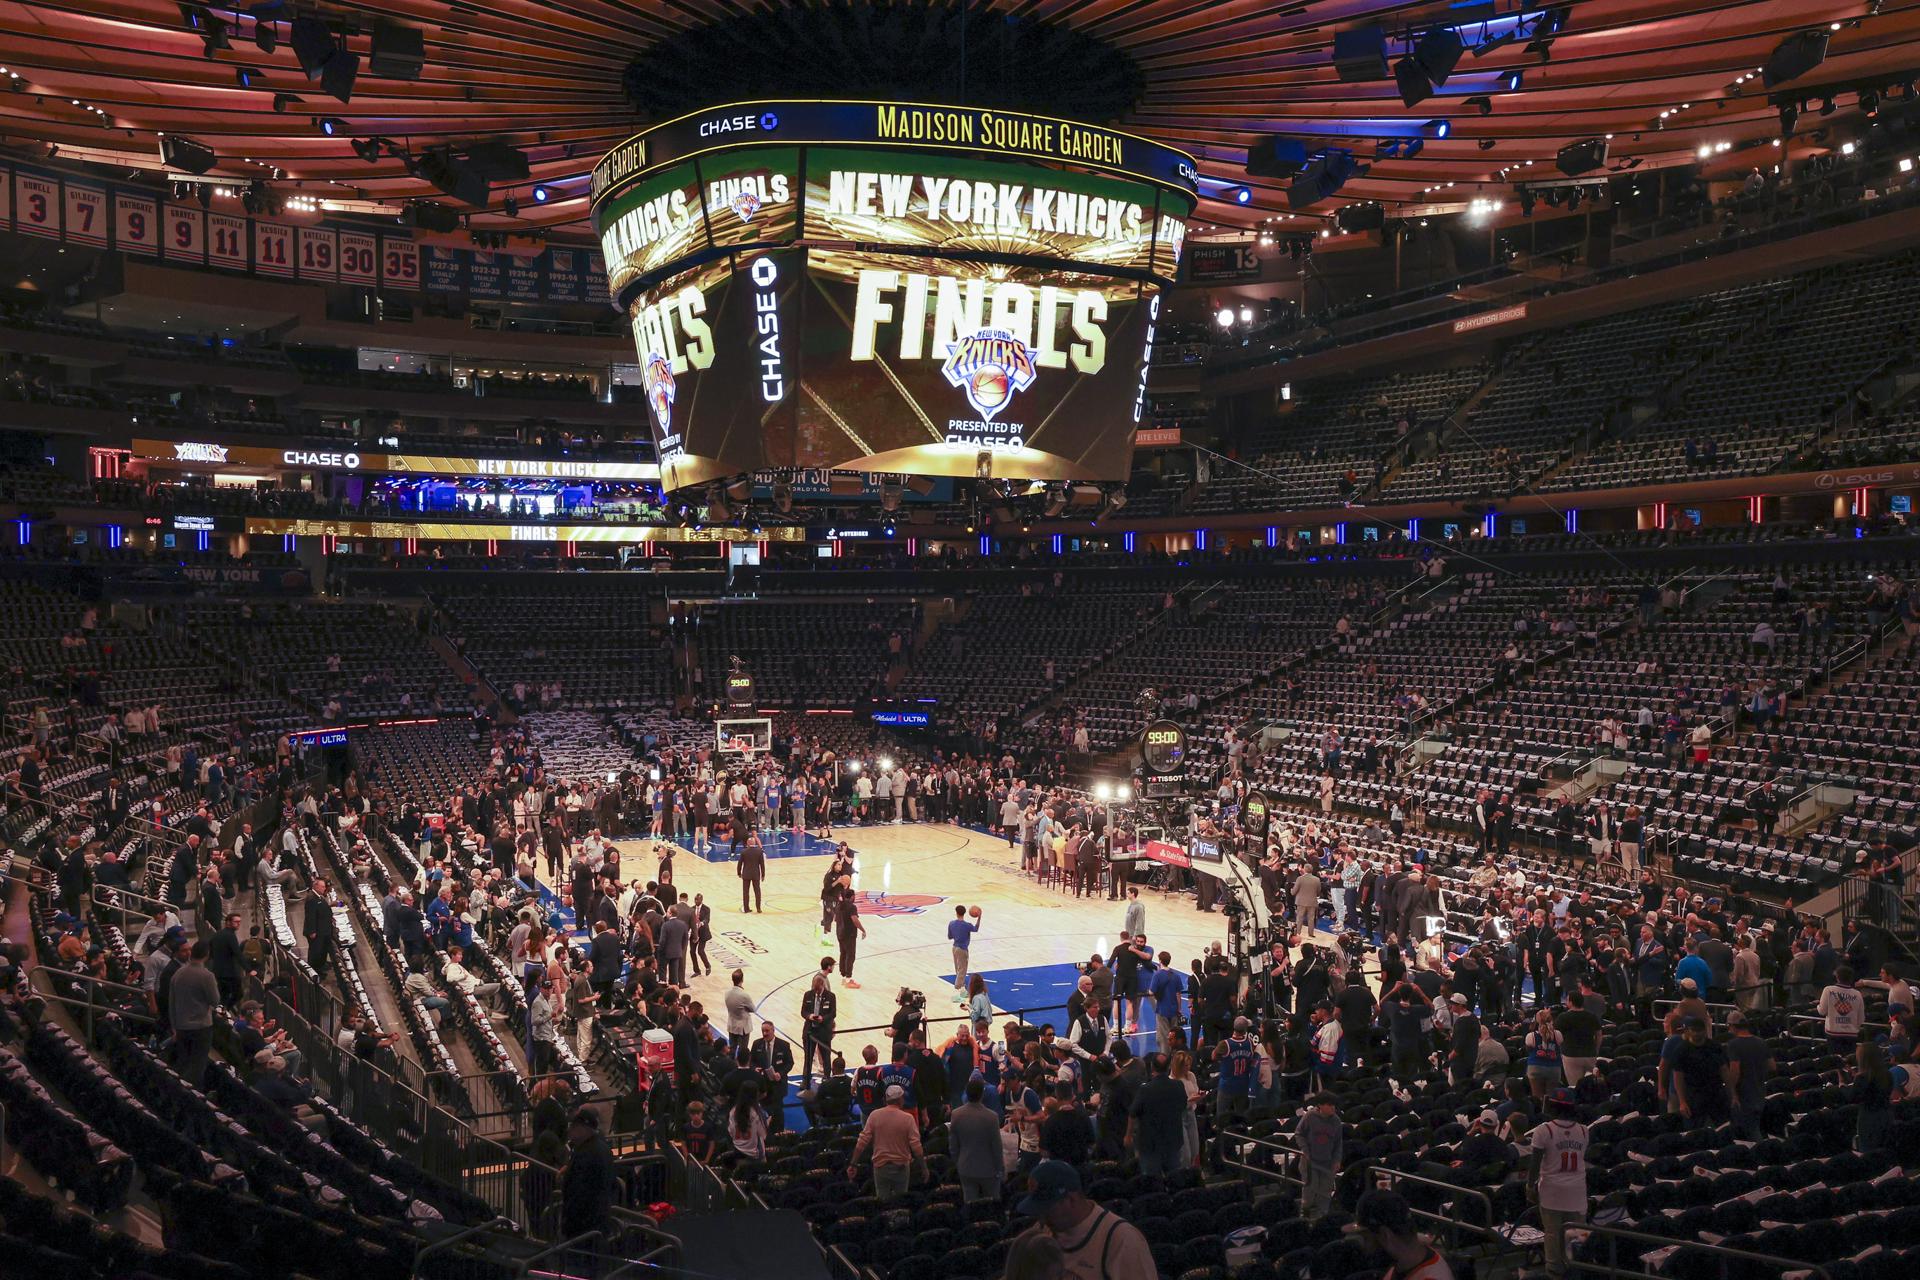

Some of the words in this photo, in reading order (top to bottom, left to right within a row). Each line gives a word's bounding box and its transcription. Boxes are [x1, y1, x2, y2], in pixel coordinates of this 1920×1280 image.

[700, 115, 756, 136] CHASE
[878, 105, 973, 143] MADISON
[980, 112, 1053, 152] SQUARE
[1059, 123, 1122, 165] GARDEN
[612, 139, 646, 184] GARDEN
[1178, 163, 1198, 185] CHAS
[710, 174, 789, 212] FINALS
[29, 194, 47, 223] 3
[77, 203, 94, 232] 7
[829, 170, 914, 217] NEW
[921, 176, 1022, 229] YORK
[1031, 187, 1142, 243] KNICKS
[128, 212, 145, 240] 9
[175, 221, 192, 248] 9
[618, 188, 690, 257] KNICKS
[215, 228, 239, 257] 11
[262, 236, 286, 264] 11
[304, 241, 332, 269] 19
[343, 247, 374, 274] 30
[386, 251, 417, 278] 35
[1234, 248, 1258, 269] 13
[850, 269, 1108, 375] FINALS
[756, 291, 783, 402] CHASE
[977, 330, 992, 338] NEW
[993, 330, 1011, 340] YORK
[947, 337, 1033, 376] KNICKS
[1134, 324, 1154, 423] CHASE
[949, 420, 1007, 432] PRESENTED
[1010, 423, 1024, 433] BY
[1154, 431, 1178, 441] LEVEL
[284, 451, 341, 466] CHASE
[478, 460, 506, 473] NEW
[511, 462, 547, 475] YORK
[1836, 471, 1895, 486] LEXUS
[511, 525, 557, 540] FINALS
[183, 568, 217, 581] NEW
[221, 569, 260, 582] YORK
[731, 679, 750, 687] 99:00
[321, 733, 347, 744] ULTRA
[1148, 731, 1178, 744] 99:00
[1157, 775, 1183, 783] TISSOT
[1233, 1057, 1246, 1076] 11
[883, 1074, 911, 1088] HOUSTON
[1560, 1151, 1578, 1172] 11
